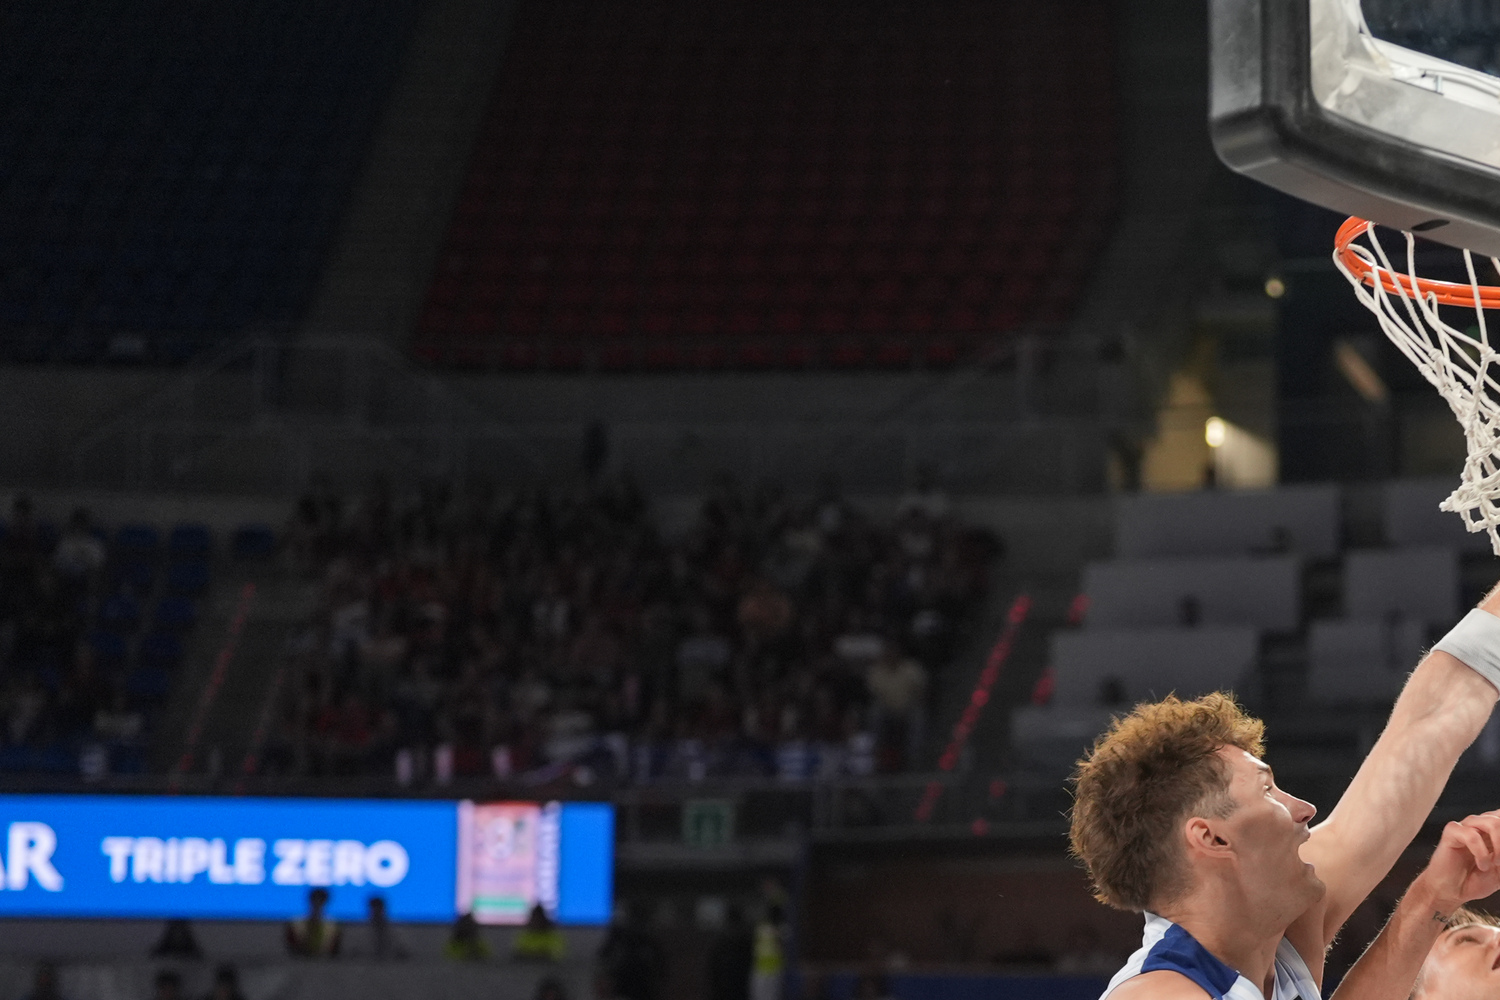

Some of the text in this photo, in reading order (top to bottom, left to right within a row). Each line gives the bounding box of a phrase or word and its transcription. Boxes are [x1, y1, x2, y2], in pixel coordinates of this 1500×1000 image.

[0, 820, 410, 892] R TRIPLE ZERO
